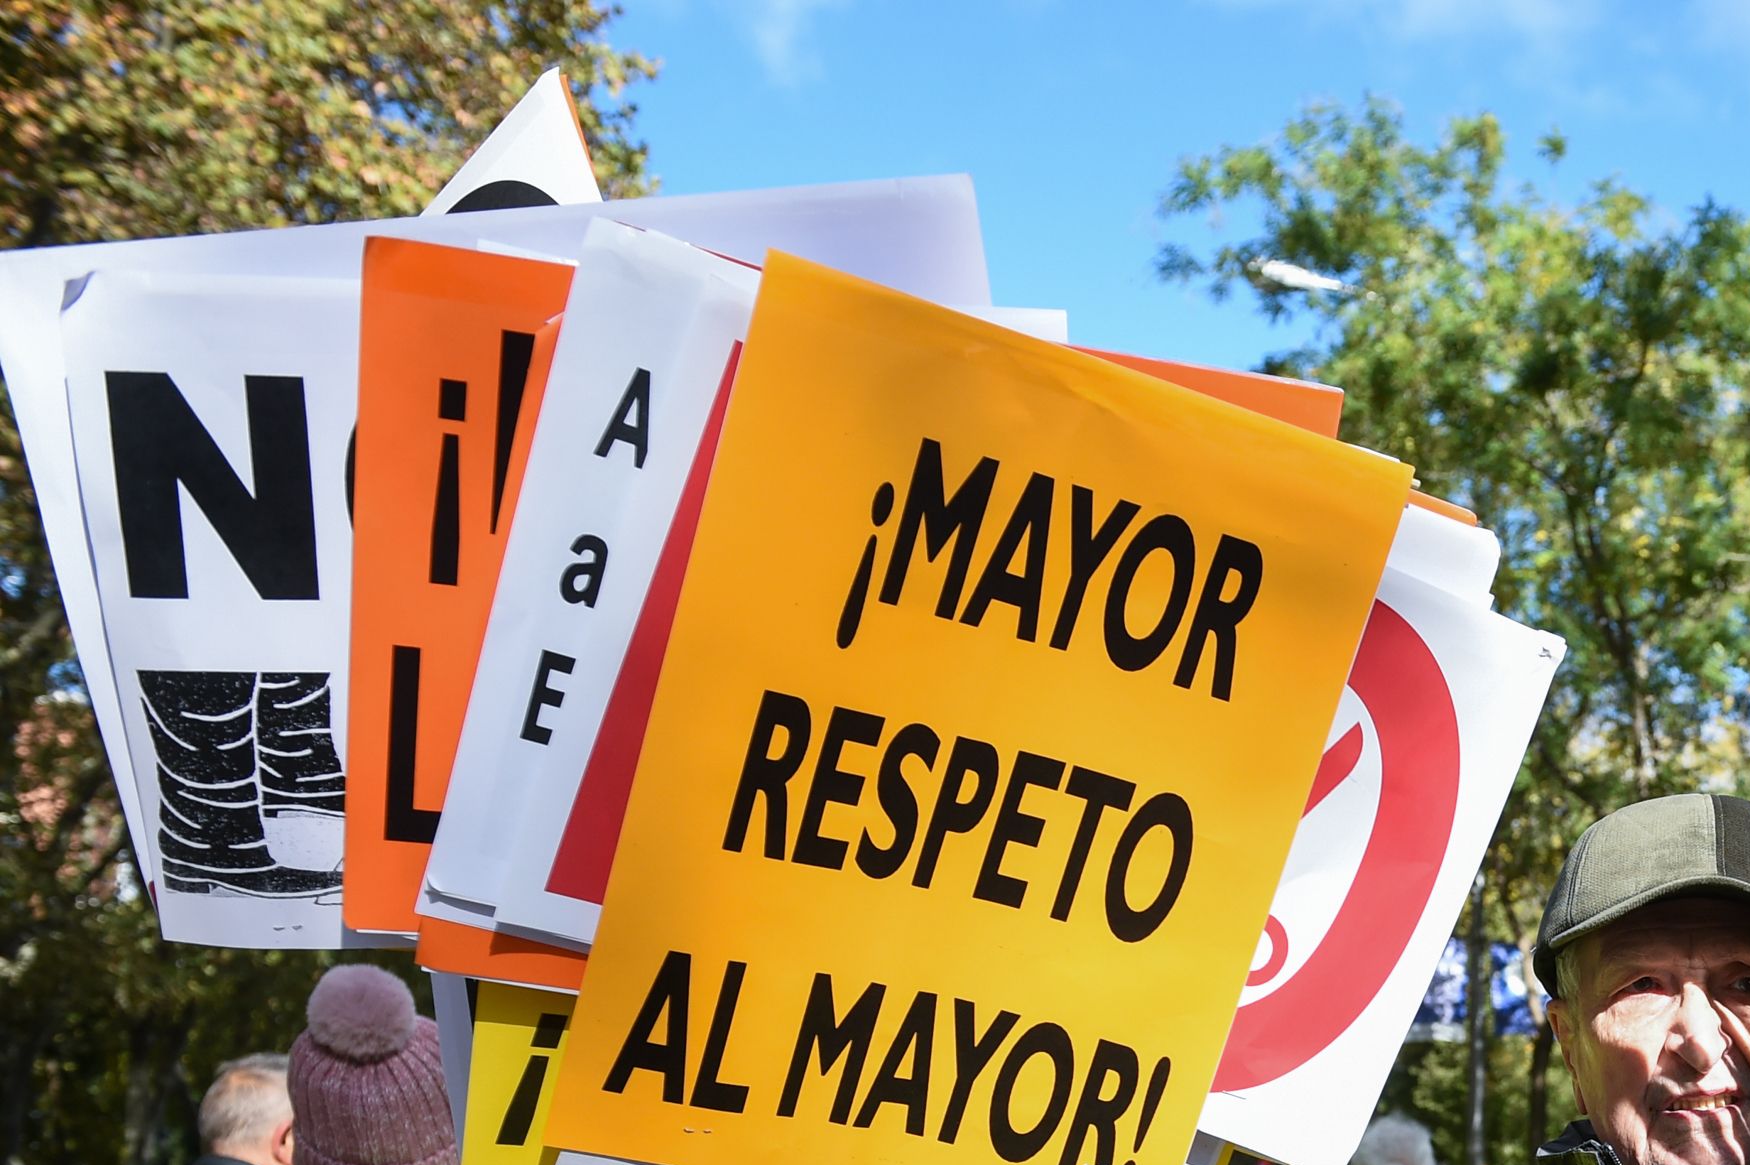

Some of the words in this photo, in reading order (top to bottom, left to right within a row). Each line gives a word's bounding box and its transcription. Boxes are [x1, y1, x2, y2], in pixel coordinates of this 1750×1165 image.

[104, 370, 360, 601] N
[835, 436, 1265, 702] ¡MAYOR
[721, 689, 1194, 943] RESPETO
[603, 949, 751, 1114] AL
